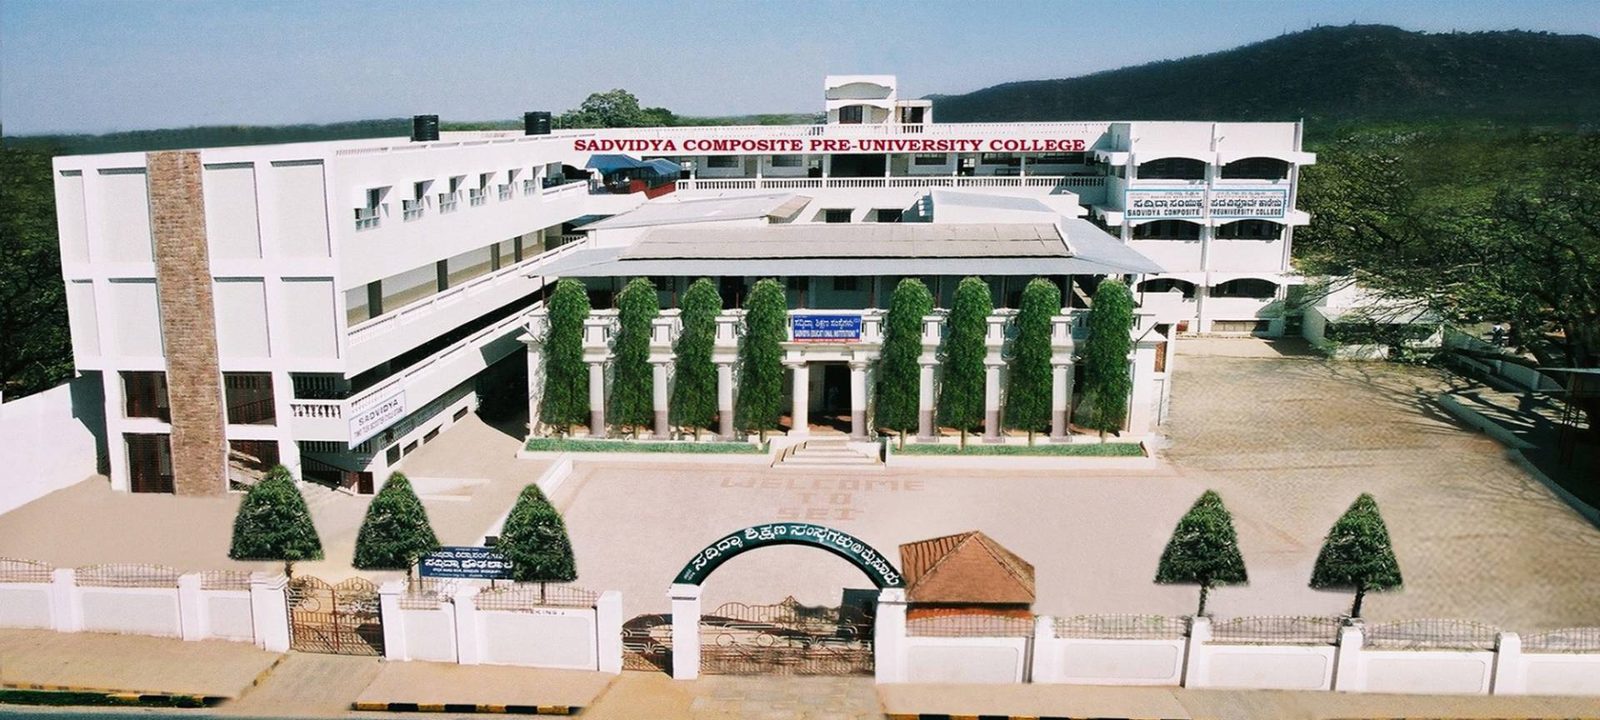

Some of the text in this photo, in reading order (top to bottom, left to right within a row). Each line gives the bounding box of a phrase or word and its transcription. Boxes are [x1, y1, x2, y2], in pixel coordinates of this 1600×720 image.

[574, 139, 1086, 151] SADVIDYA COMPOSITE PRE-UNIVERSITY COLLEGE
[358, 399, 398, 426] SADVIDYA
[720, 478, 924, 491] WELCOME
[798, 492, 851, 504] TO
[745, 524, 787, 540] ಶಿಕ್ಷಣ
